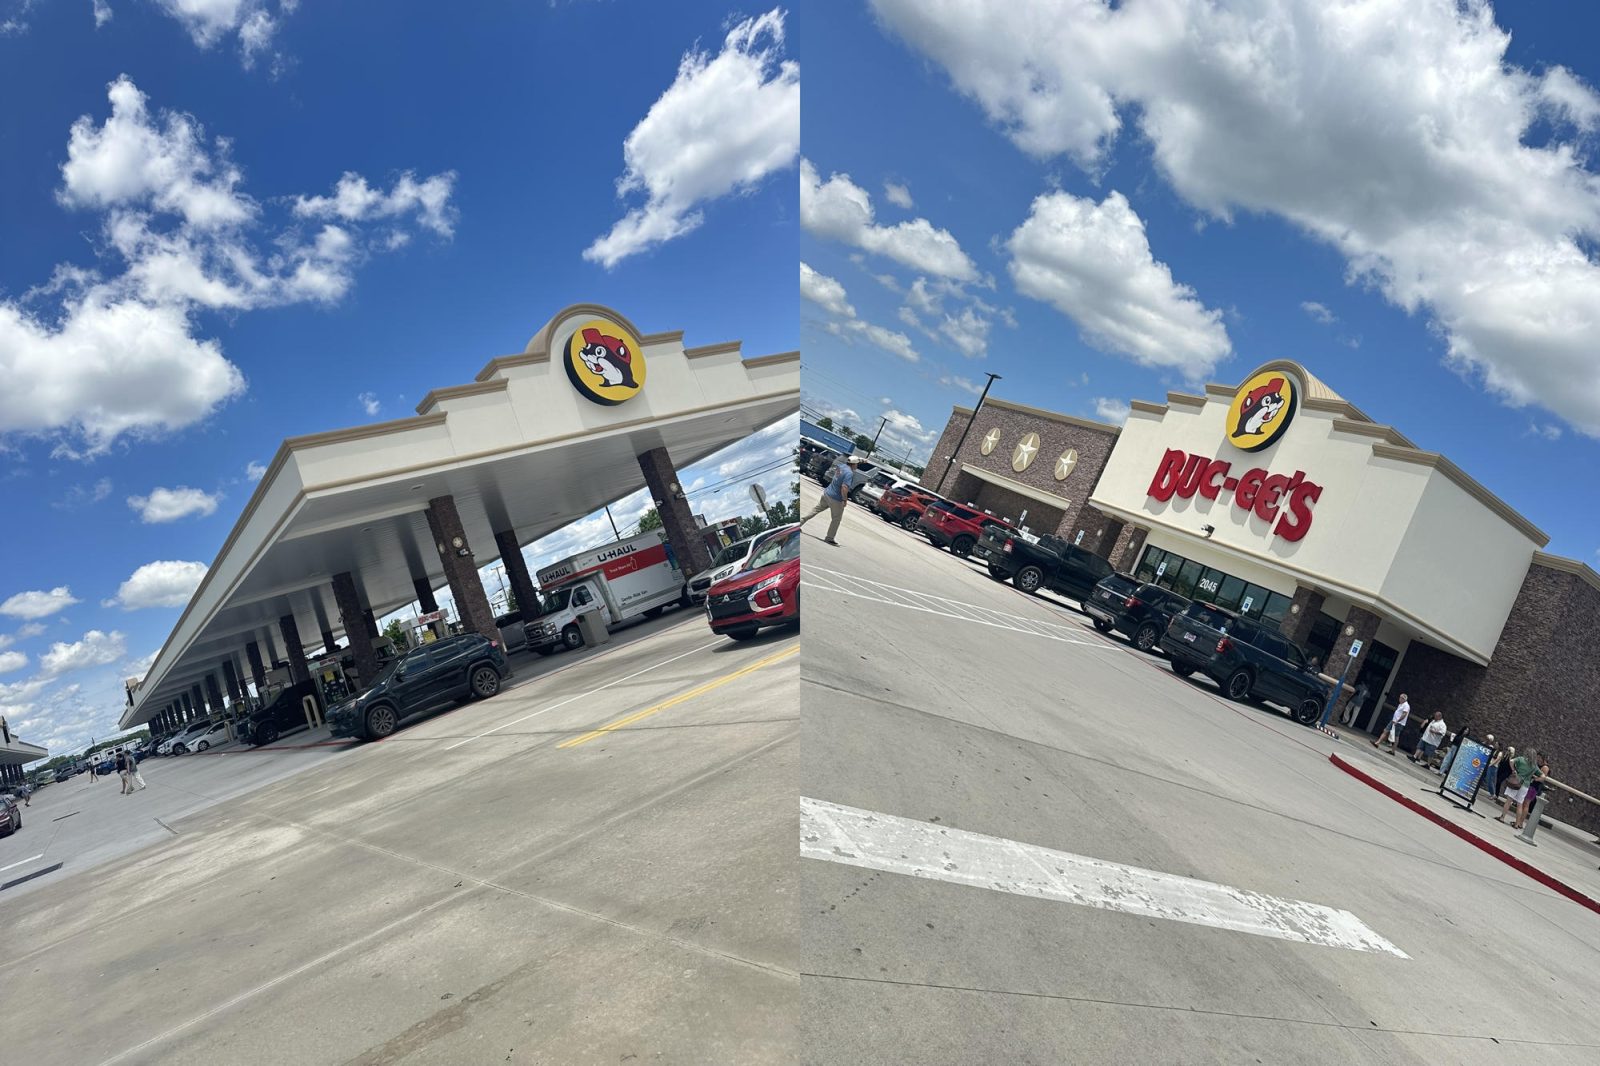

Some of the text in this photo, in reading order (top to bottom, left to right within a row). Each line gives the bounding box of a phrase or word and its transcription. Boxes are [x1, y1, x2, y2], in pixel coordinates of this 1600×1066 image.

[1147, 447, 1323, 542] BUC-EE'S
[597, 543, 637, 562] U-HAUL
[541, 566, 571, 583] U-HAUL
[1199, 577, 1218, 593] 2045
